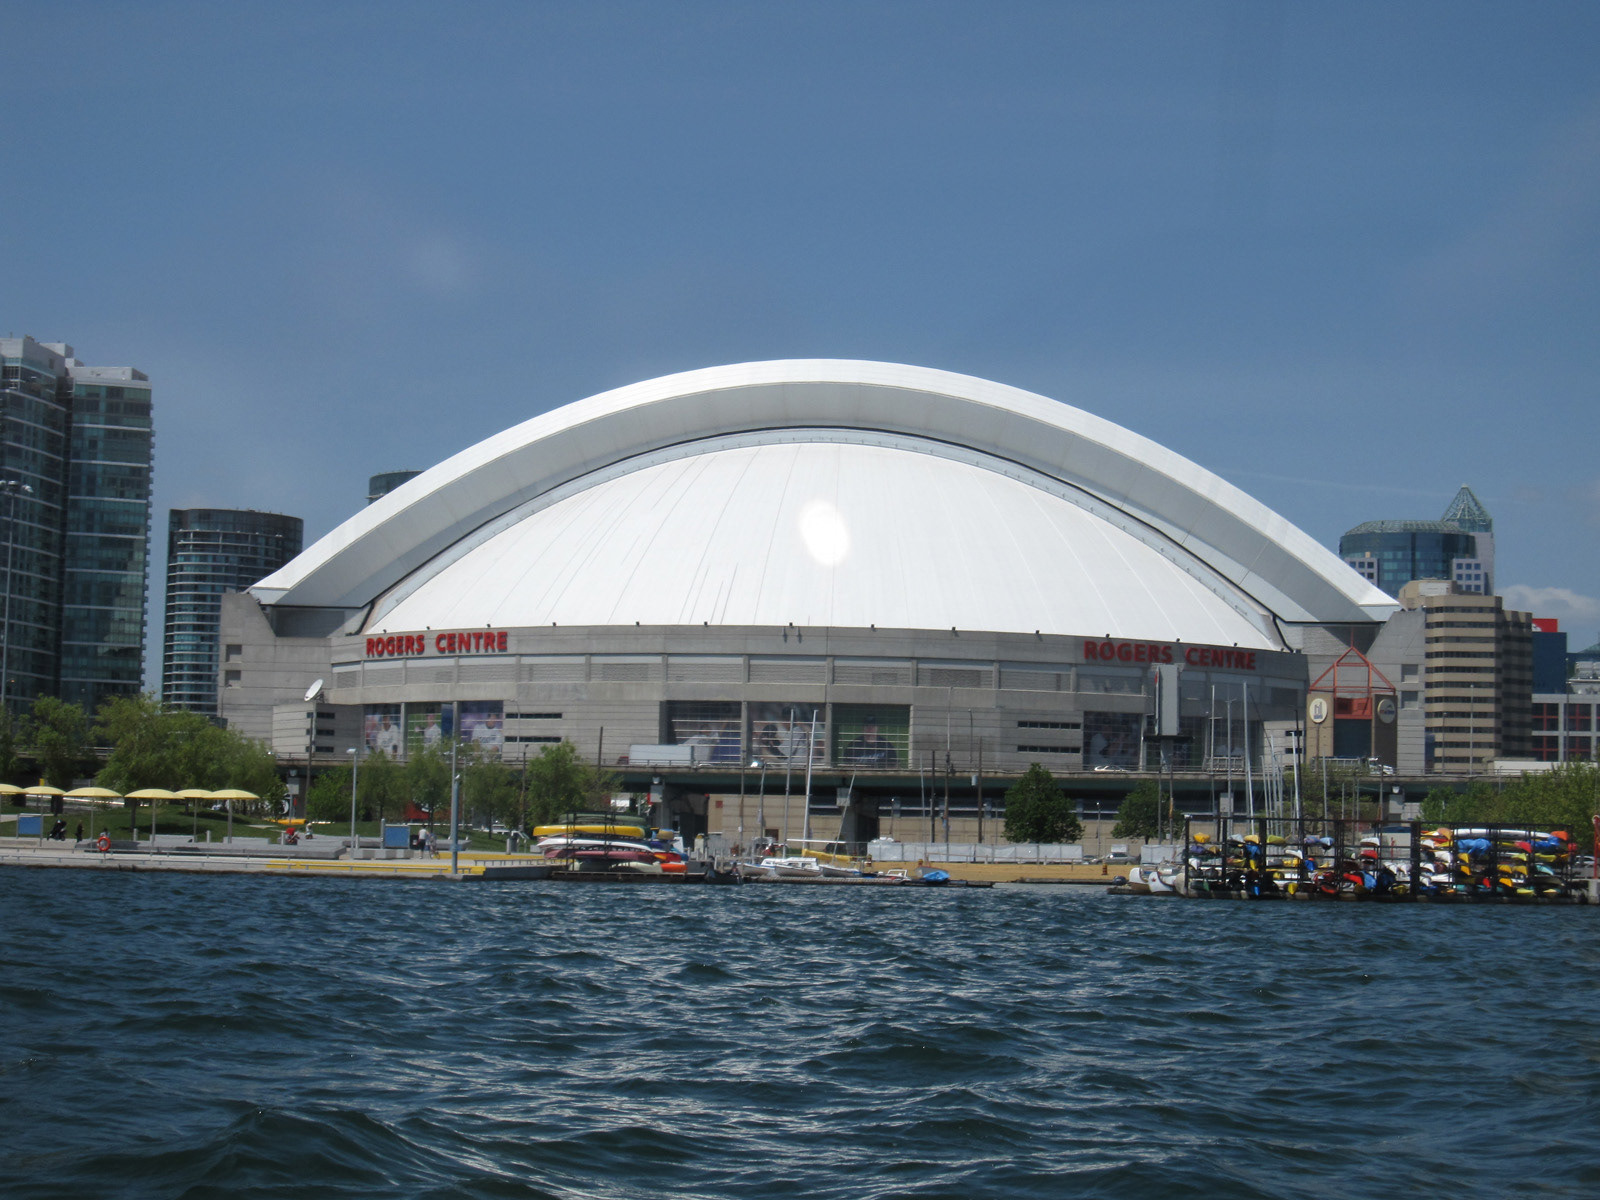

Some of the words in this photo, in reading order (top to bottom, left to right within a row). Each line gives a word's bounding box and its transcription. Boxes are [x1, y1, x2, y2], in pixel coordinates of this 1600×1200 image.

[366, 634, 425, 657] ROGERS
[436, 631, 507, 653] CENTRE
[1084, 640, 1173, 664] ROGERS
[1185, 646, 1256, 669] CENTRE
